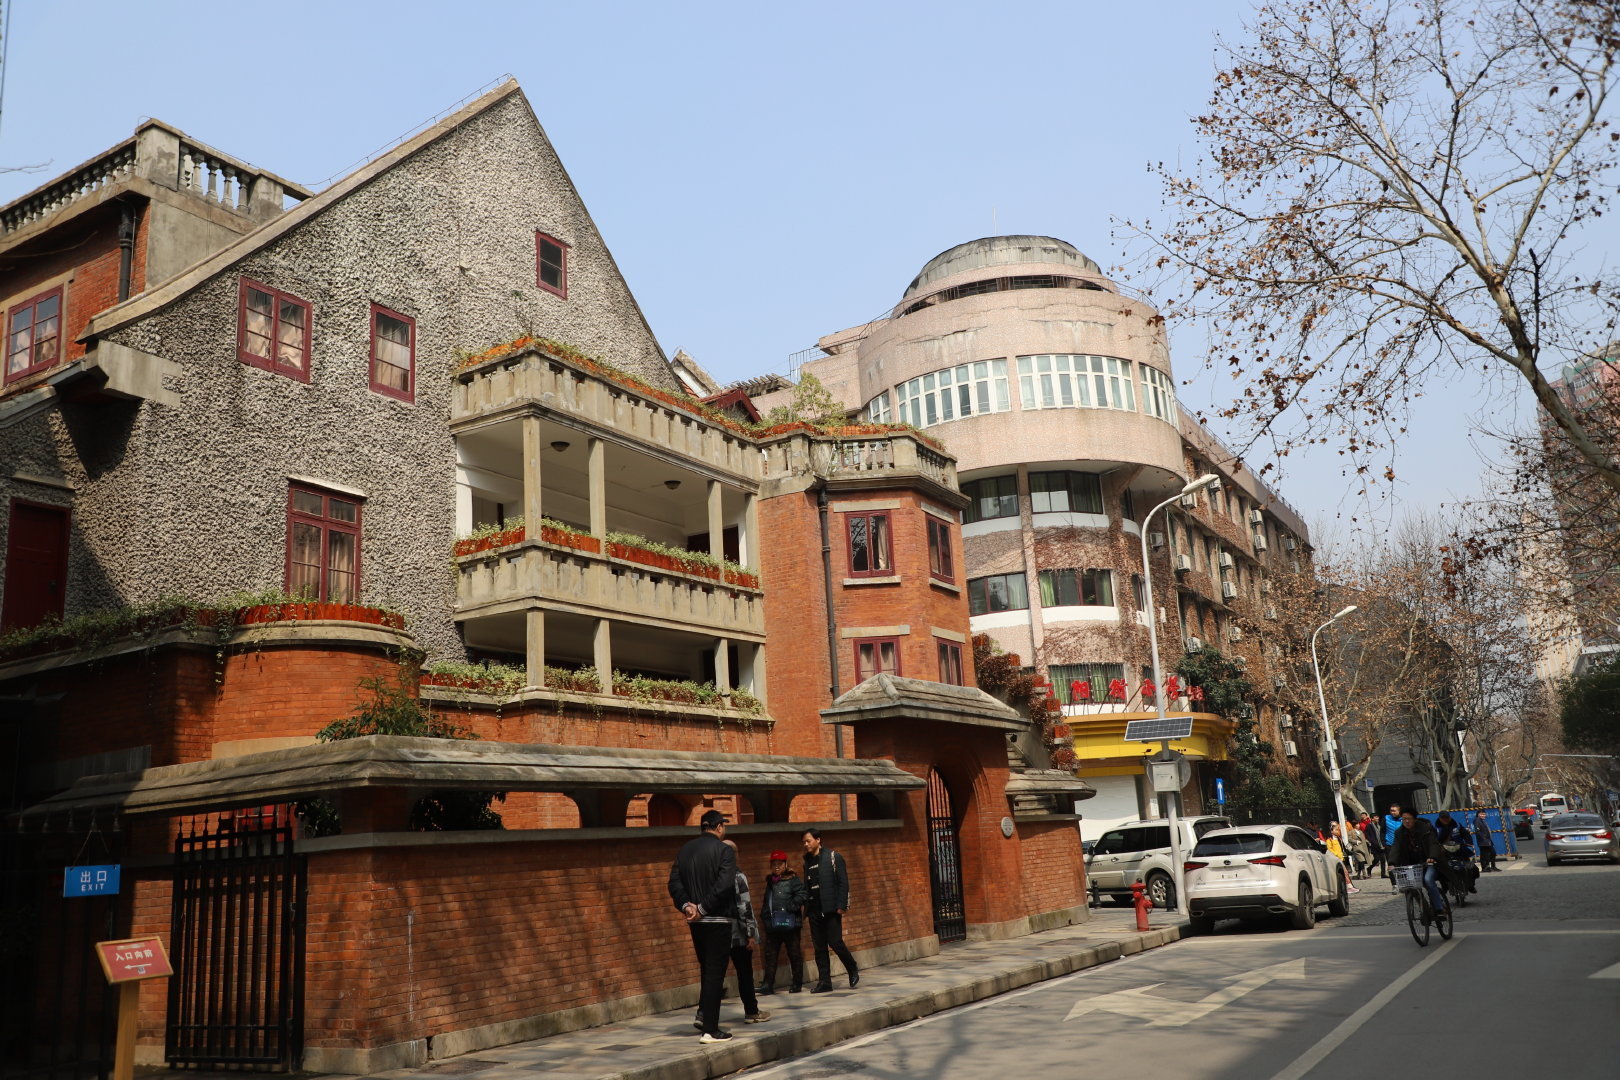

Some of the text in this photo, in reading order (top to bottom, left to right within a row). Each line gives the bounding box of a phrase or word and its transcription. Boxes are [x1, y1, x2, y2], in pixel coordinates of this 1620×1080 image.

[80, 870, 107, 883] 出口
[81, 883, 105, 892] EXIT
[115, 949, 153, 961] 入口向前
